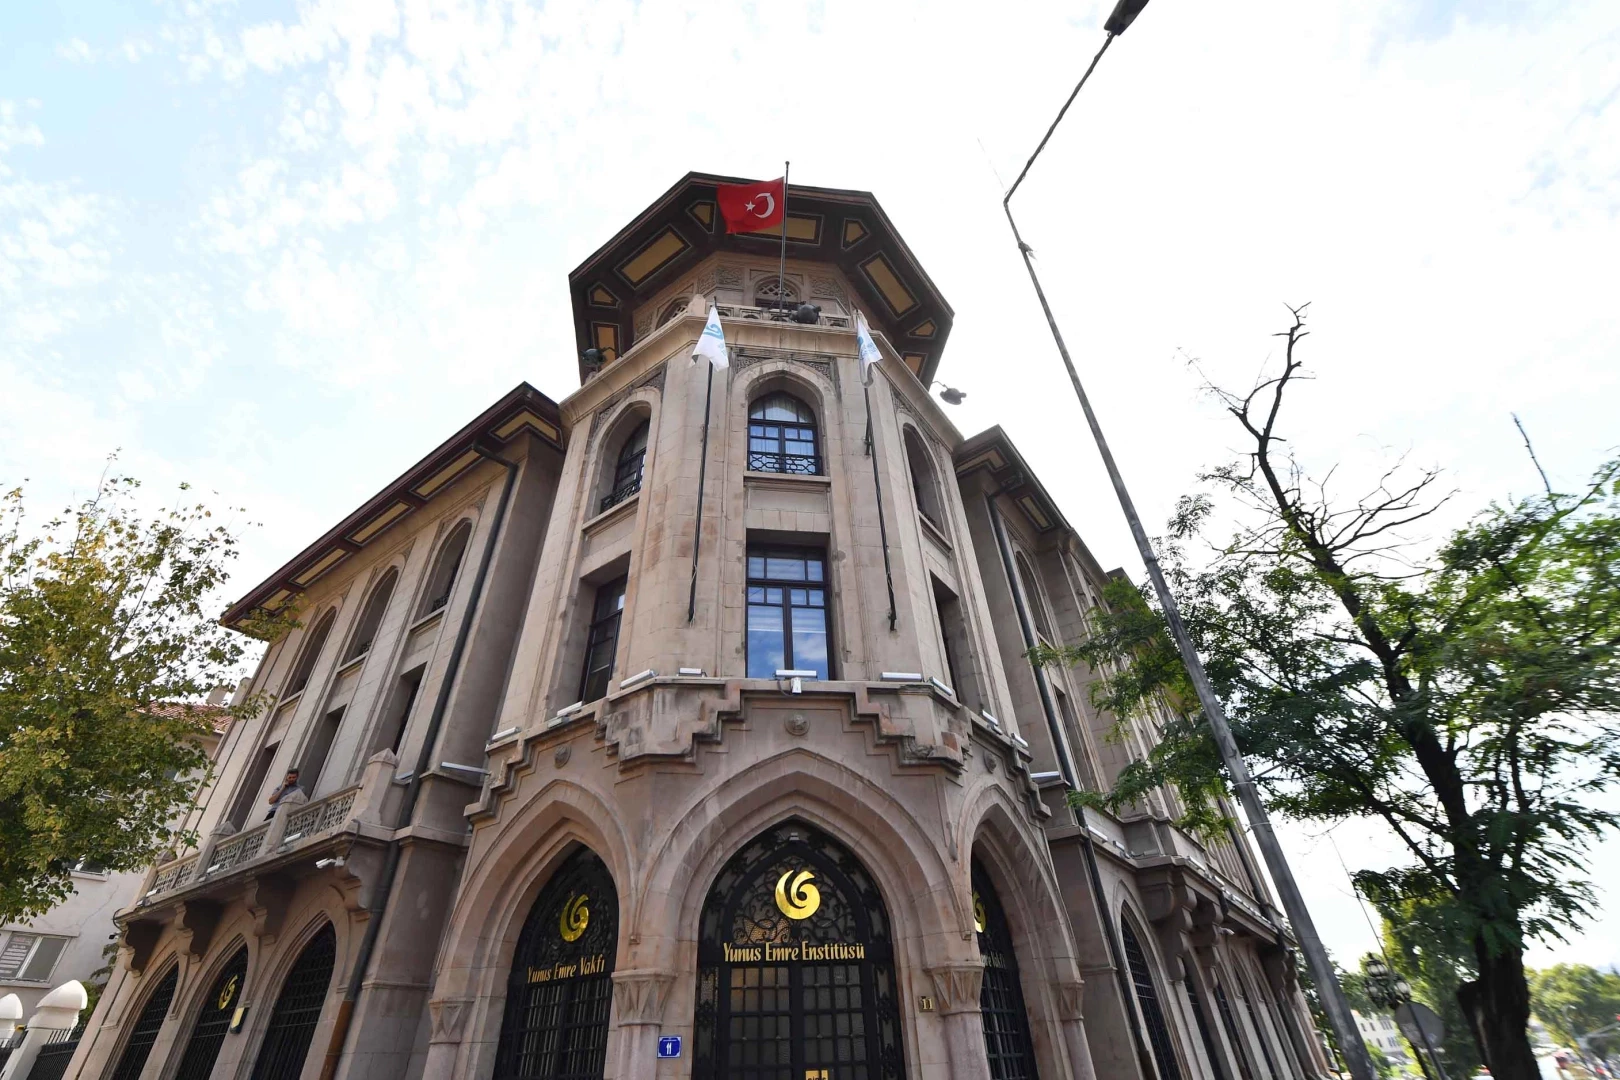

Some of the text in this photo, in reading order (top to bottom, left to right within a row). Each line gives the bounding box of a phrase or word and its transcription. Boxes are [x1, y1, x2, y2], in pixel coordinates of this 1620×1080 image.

[723, 940, 865, 963] Yunus Emre Enstitüsü
[527, 953, 605, 984] Yunus Emre Vakfı
